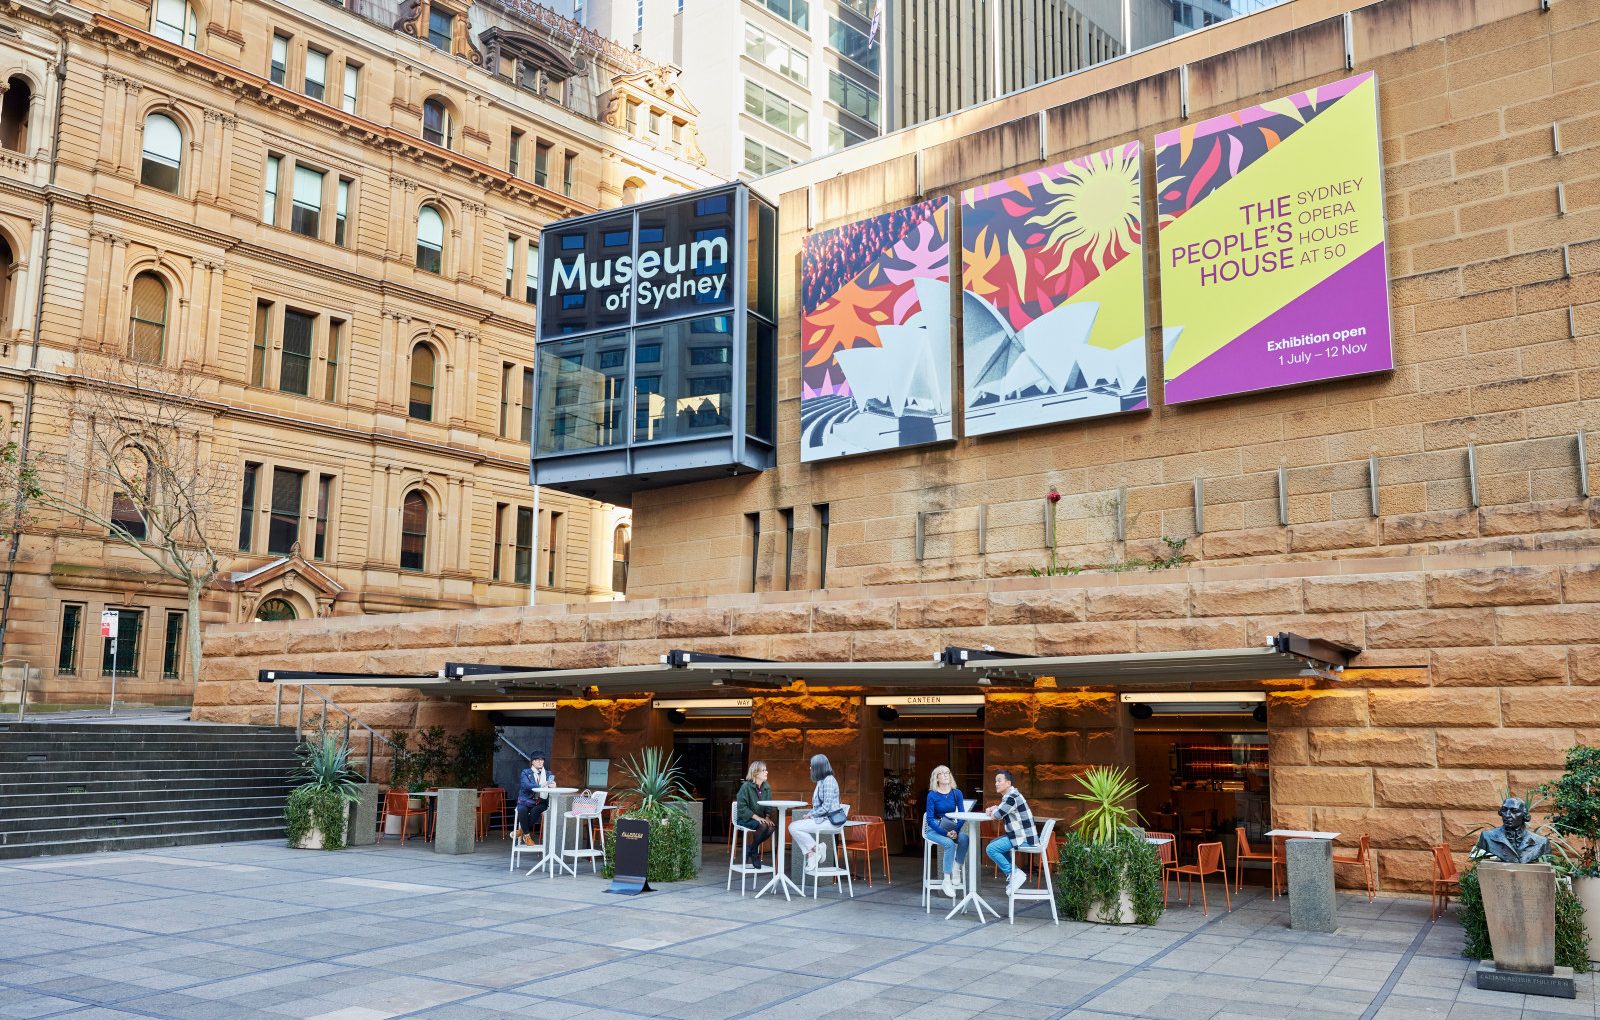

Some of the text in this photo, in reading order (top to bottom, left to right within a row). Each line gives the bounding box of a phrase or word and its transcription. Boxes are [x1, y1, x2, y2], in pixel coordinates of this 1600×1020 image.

[1297, 177, 1363, 205] SYDNEY
[1240, 195, 1292, 225] THE
[1298, 200, 1356, 225] OPERA
[1172, 221, 1293, 268] PEOPLE’S
[1299, 219, 1359, 245] HOUSE
[550, 236, 728, 297] Museum
[1200, 247, 1294, 287] HOUSE
[1300, 243, 1346, 266] AT 50
[605, 272, 727, 311] of Sydney
[1267, 326, 1366, 352] Exhibition open
[1278, 355, 1284, 366] 1
[1287, 351, 1312, 365] July
[1325, 346, 1339, 358] 12
[1342, 343, 1368, 356] Nov
[907, 696, 941, 704] CANTEEN
